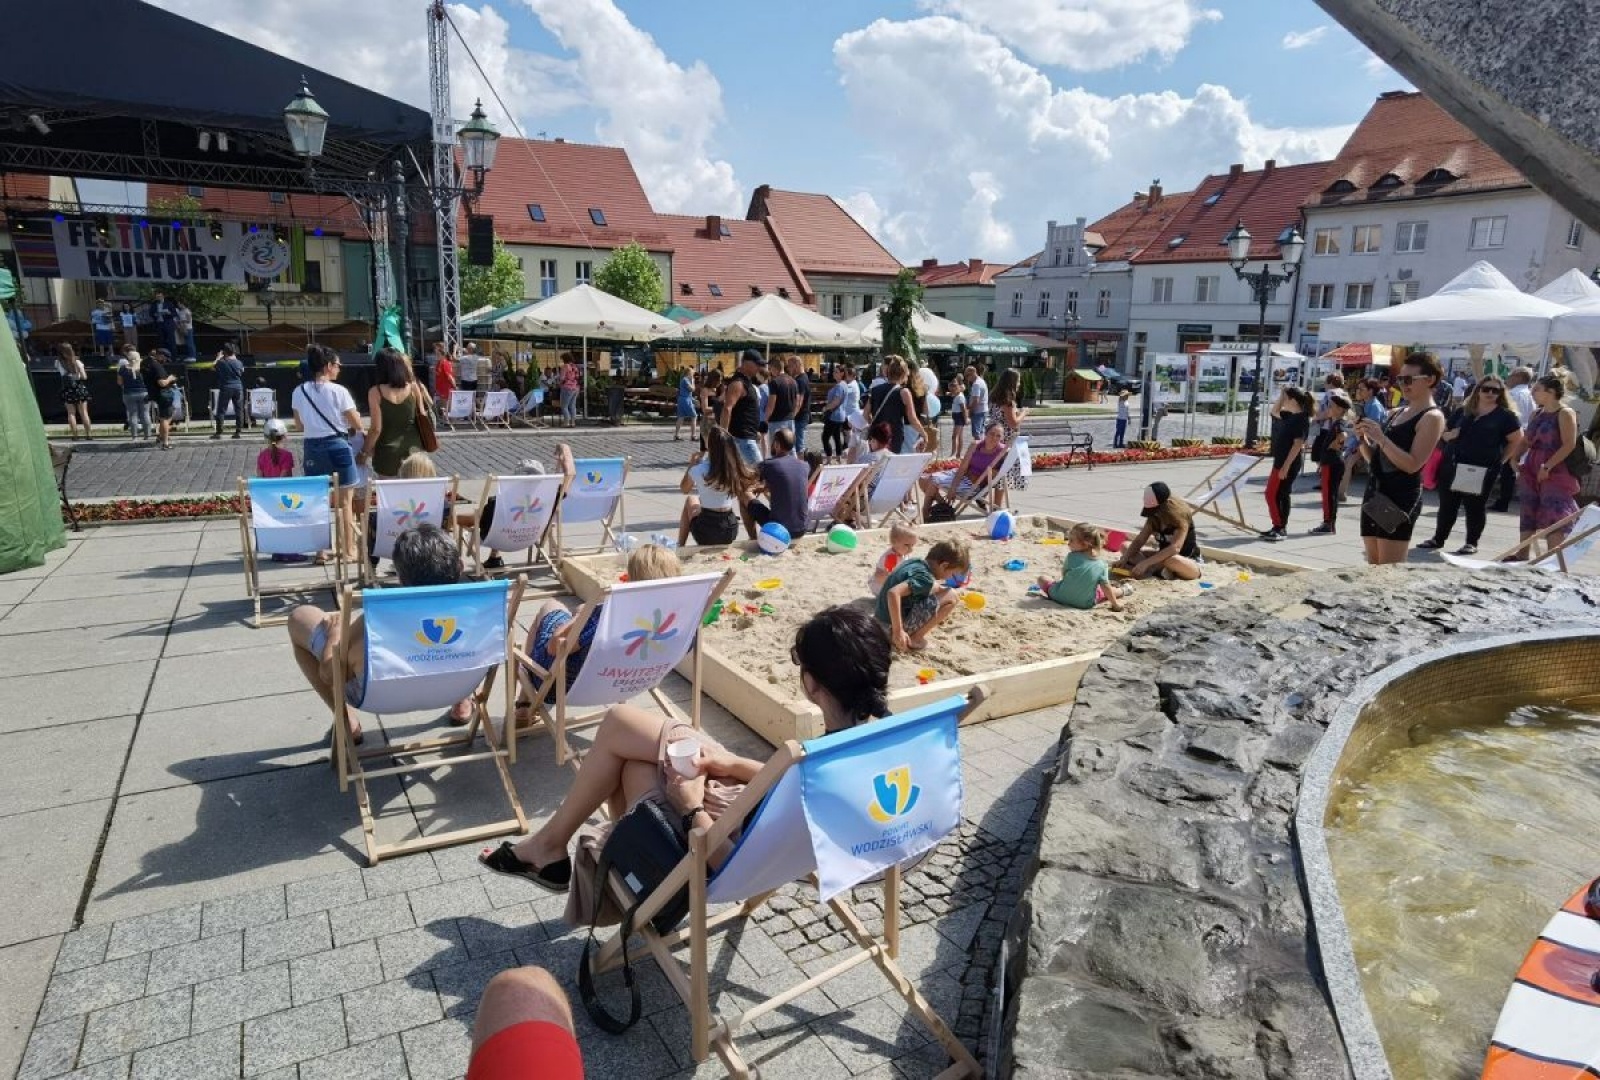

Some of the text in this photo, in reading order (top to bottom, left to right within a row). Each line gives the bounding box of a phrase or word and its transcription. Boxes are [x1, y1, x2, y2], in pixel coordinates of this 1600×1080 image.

[67, 218, 202, 252] FESTIWAL
[87, 250, 228, 280] KULTURY
[851, 820, 933, 857] WODZISŁAWSKI
